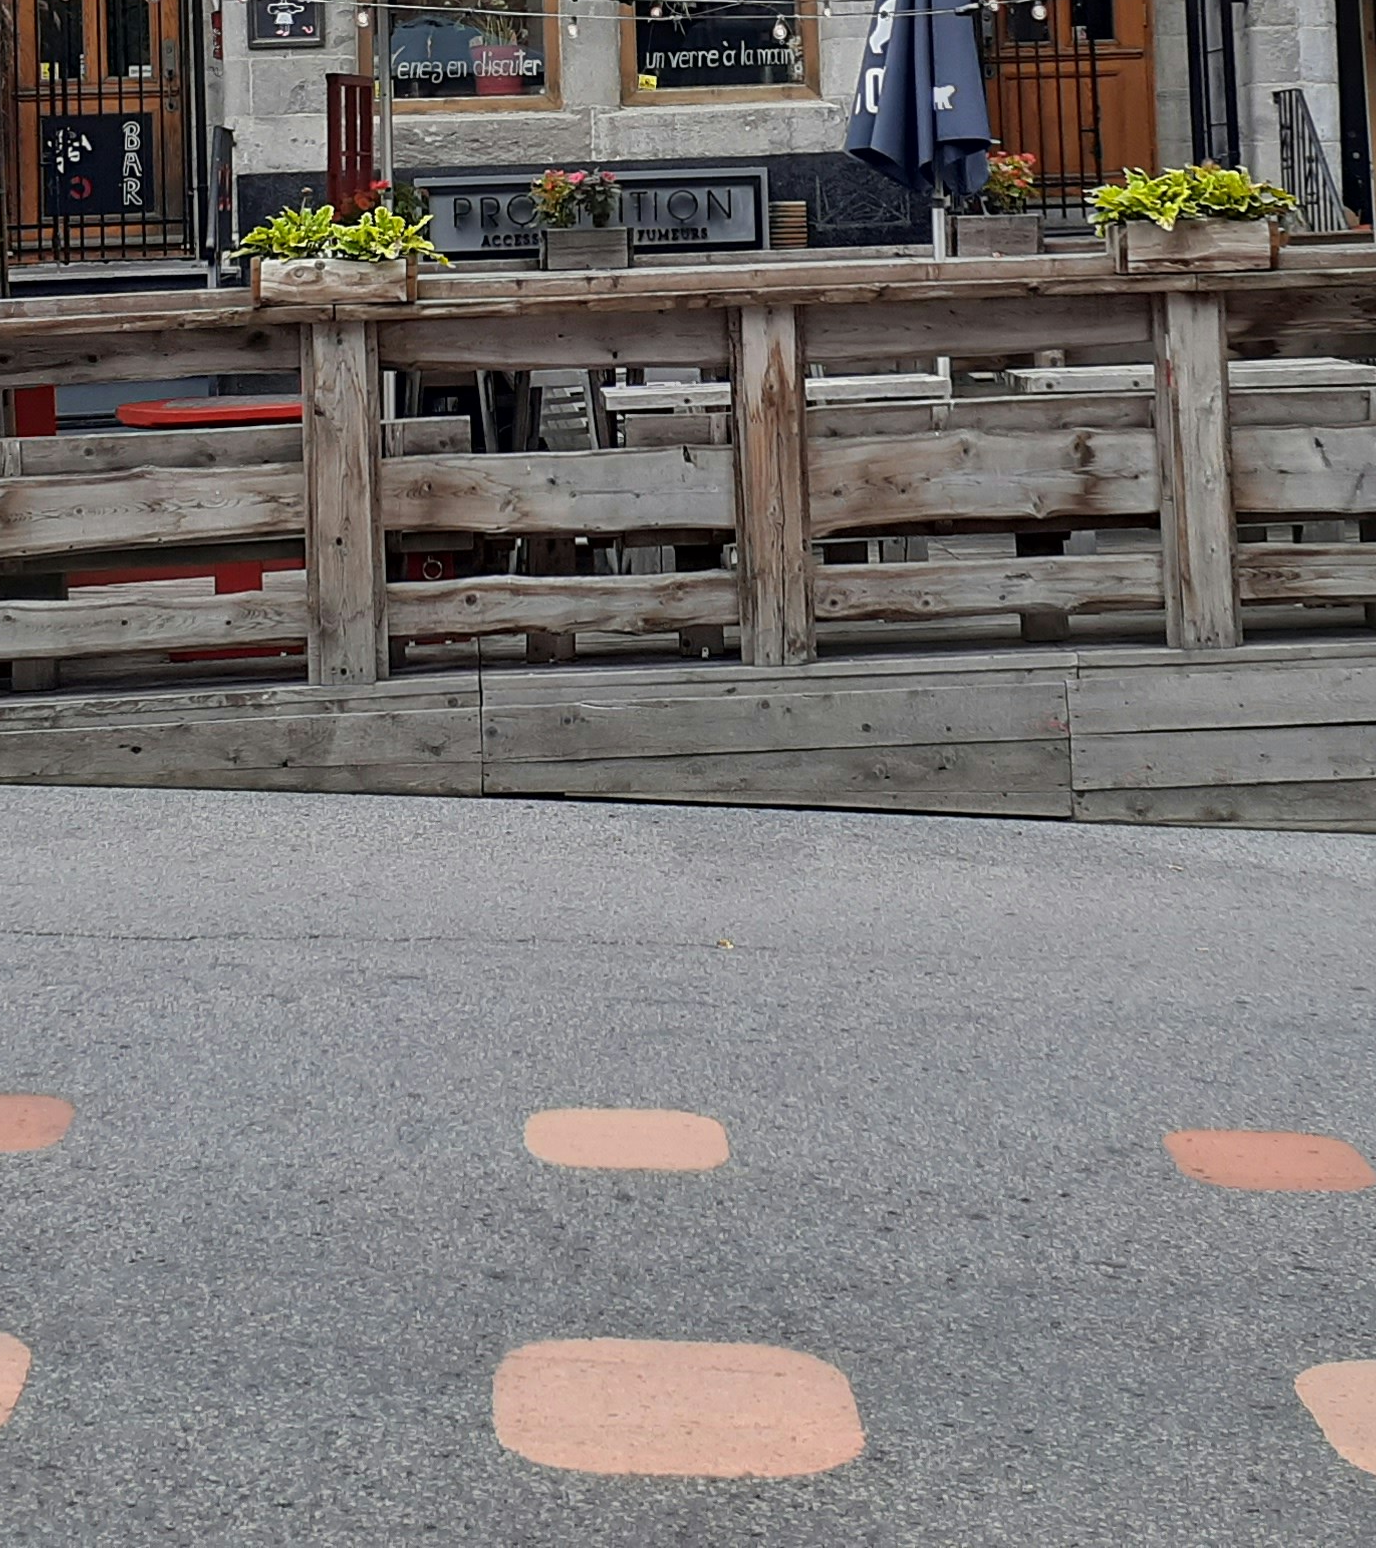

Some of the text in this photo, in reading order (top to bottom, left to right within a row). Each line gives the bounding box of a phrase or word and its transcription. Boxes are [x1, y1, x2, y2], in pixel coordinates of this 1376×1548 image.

[446, 59, 468, 79] en
[473, 48, 543, 77] discuter
[646, 40, 796, 69] un verre à la main
[122, 120, 143, 206] BAR
[452, 188, 733, 229] PROITION
[637, 227, 709, 243] FUMEURS
